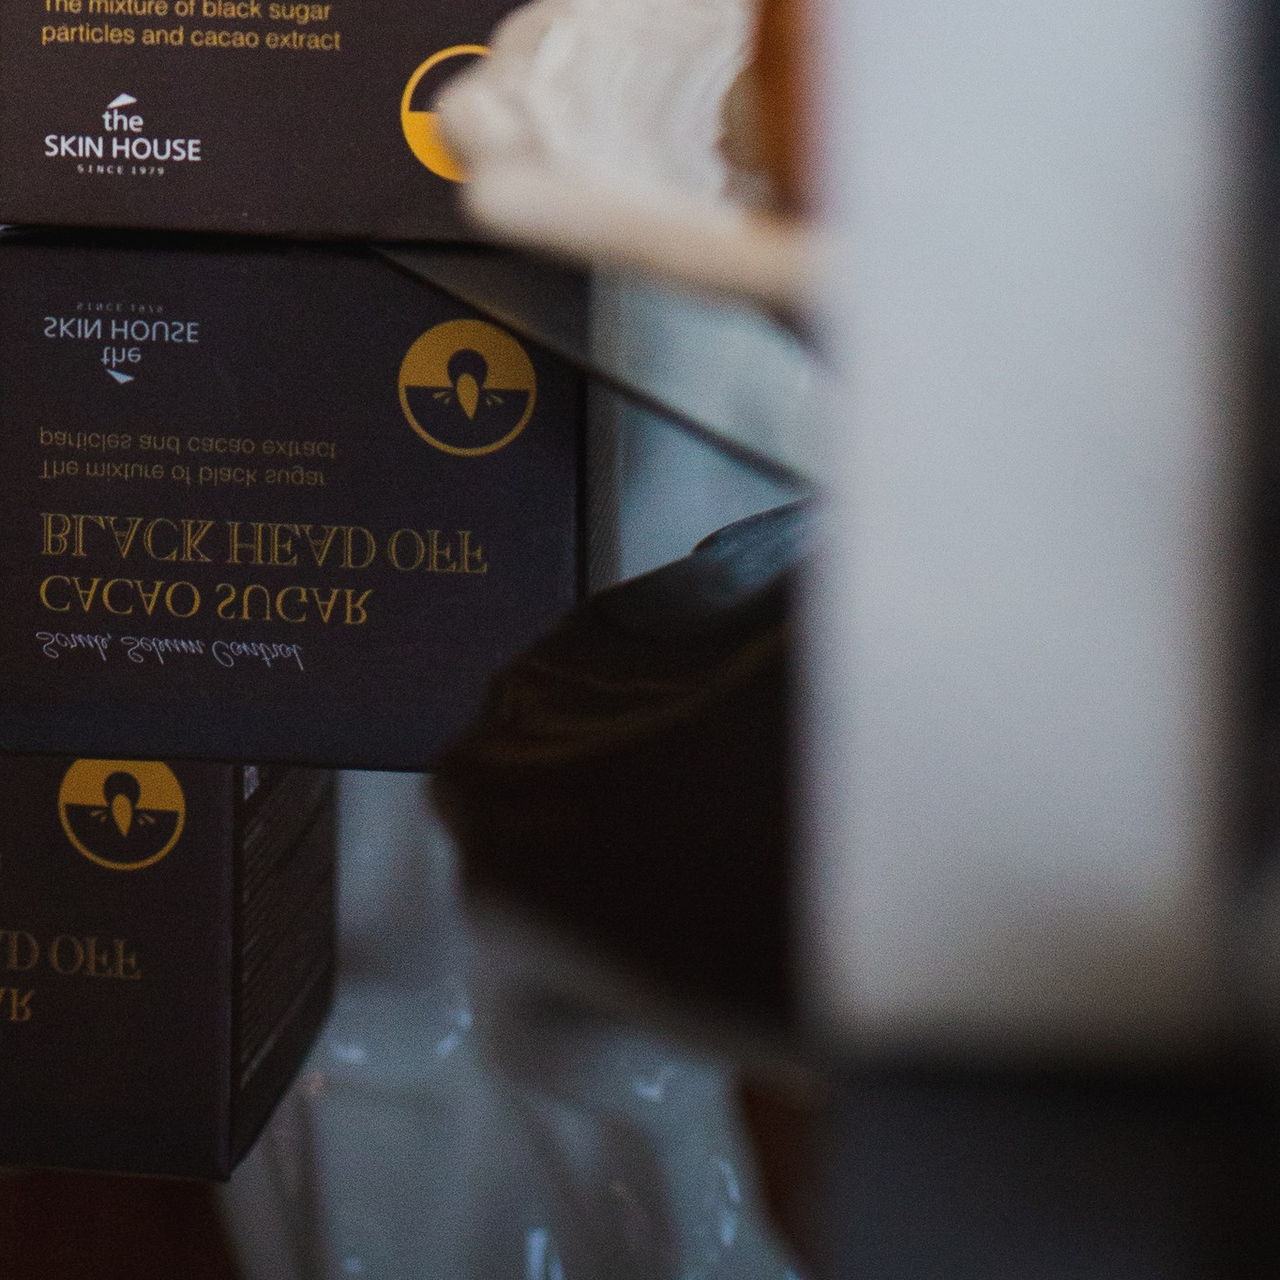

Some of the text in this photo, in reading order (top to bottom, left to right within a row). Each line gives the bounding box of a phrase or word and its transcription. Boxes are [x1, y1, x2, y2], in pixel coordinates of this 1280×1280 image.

[269, 3, 331, 25] sugar
[42, 23, 340, 50] particles and cacao extract
[102, 108, 143, 133] the
[45, 134, 201, 161] SKIN HOUSE
